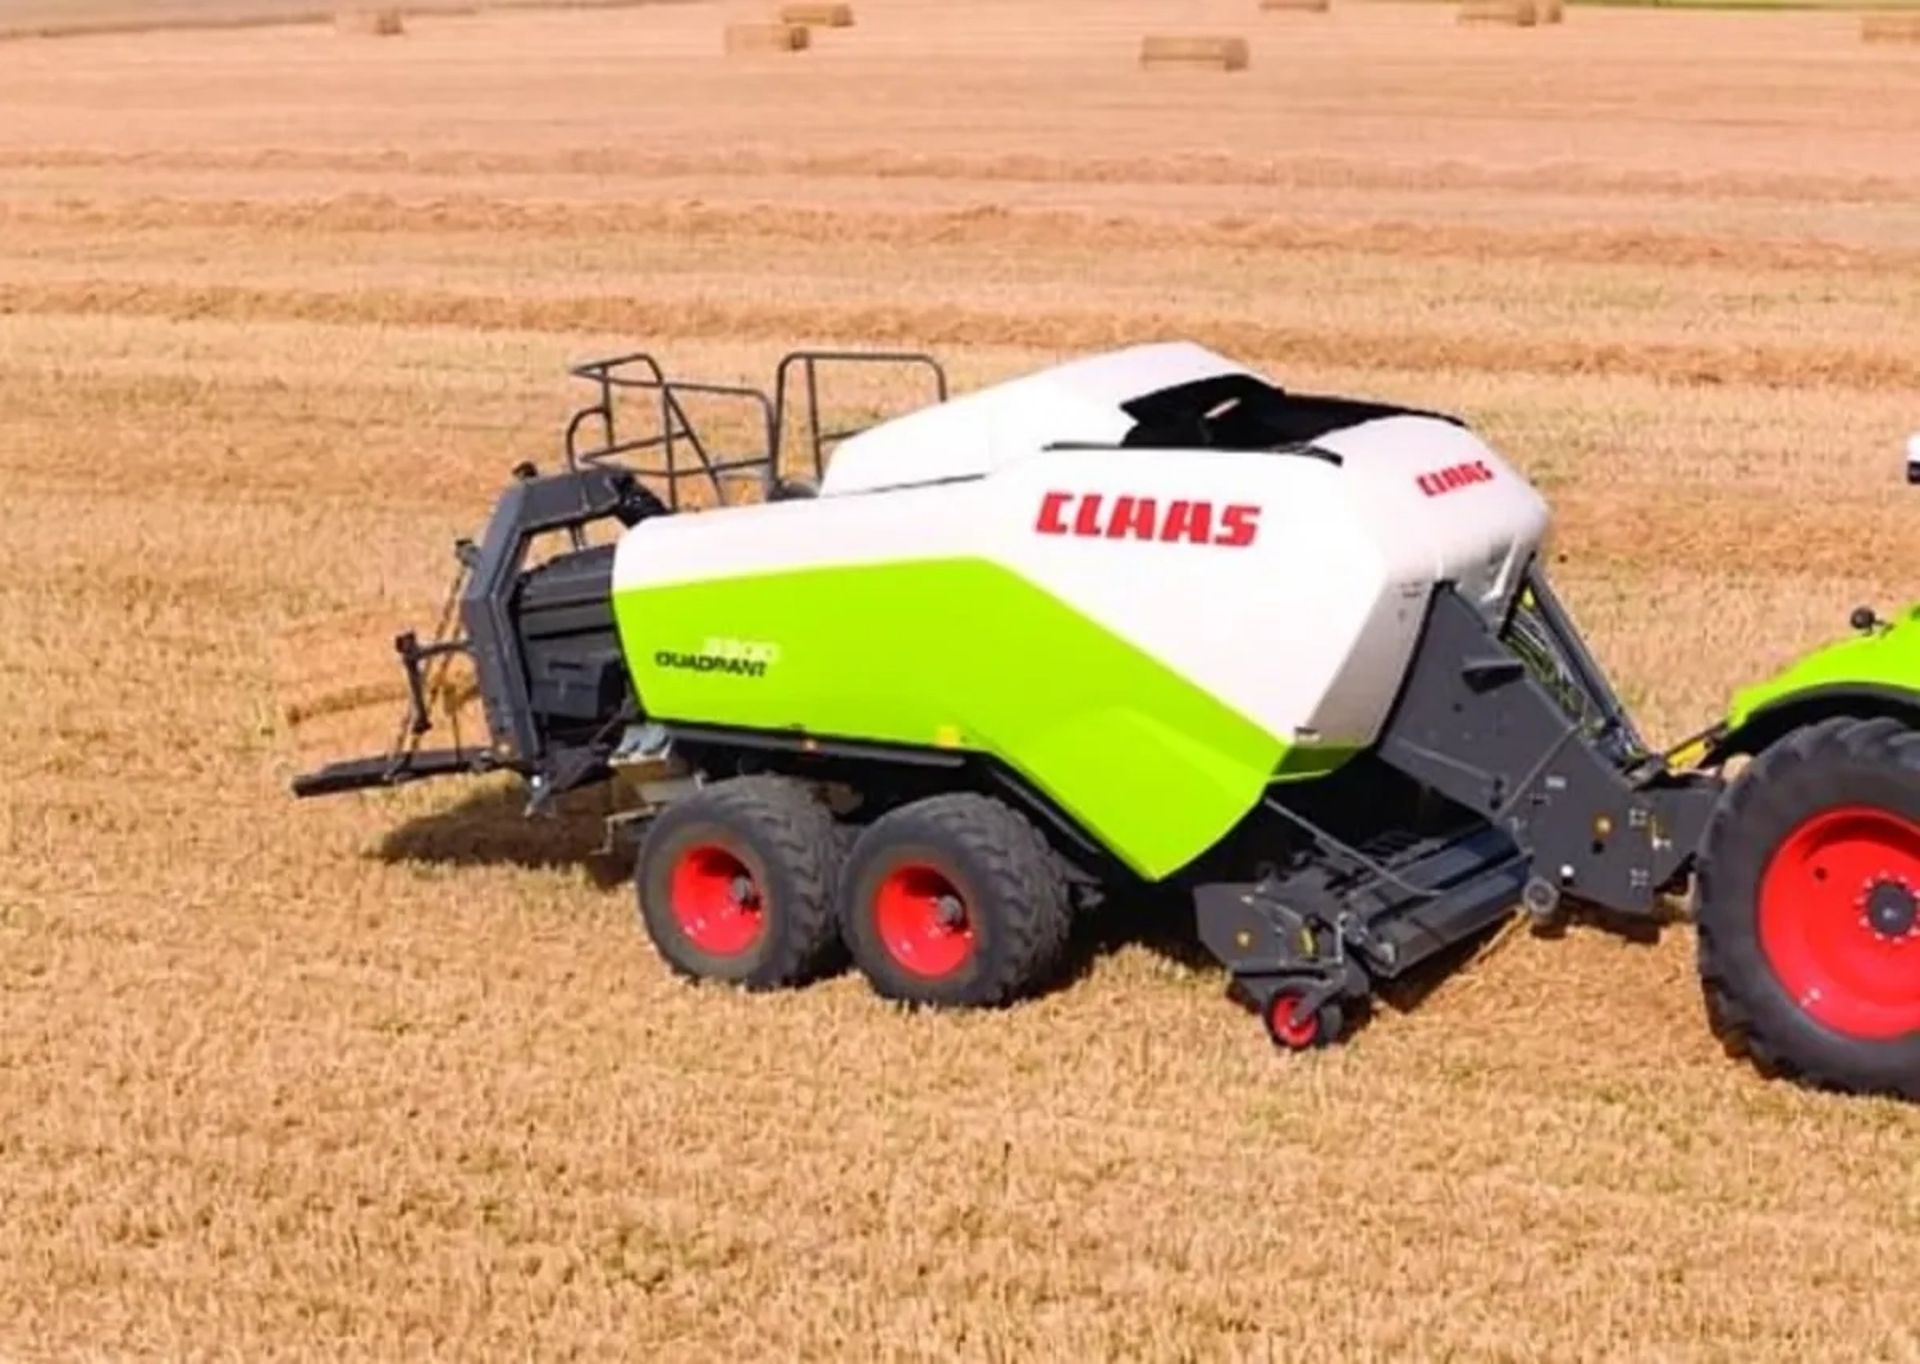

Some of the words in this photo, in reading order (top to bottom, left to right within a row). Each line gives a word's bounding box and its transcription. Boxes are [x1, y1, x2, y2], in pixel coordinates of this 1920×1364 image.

[1416, 460, 1493, 498] CLAAS
[1035, 491, 1261, 548] CLAAS
[655, 651, 767, 677] QUADRANT
